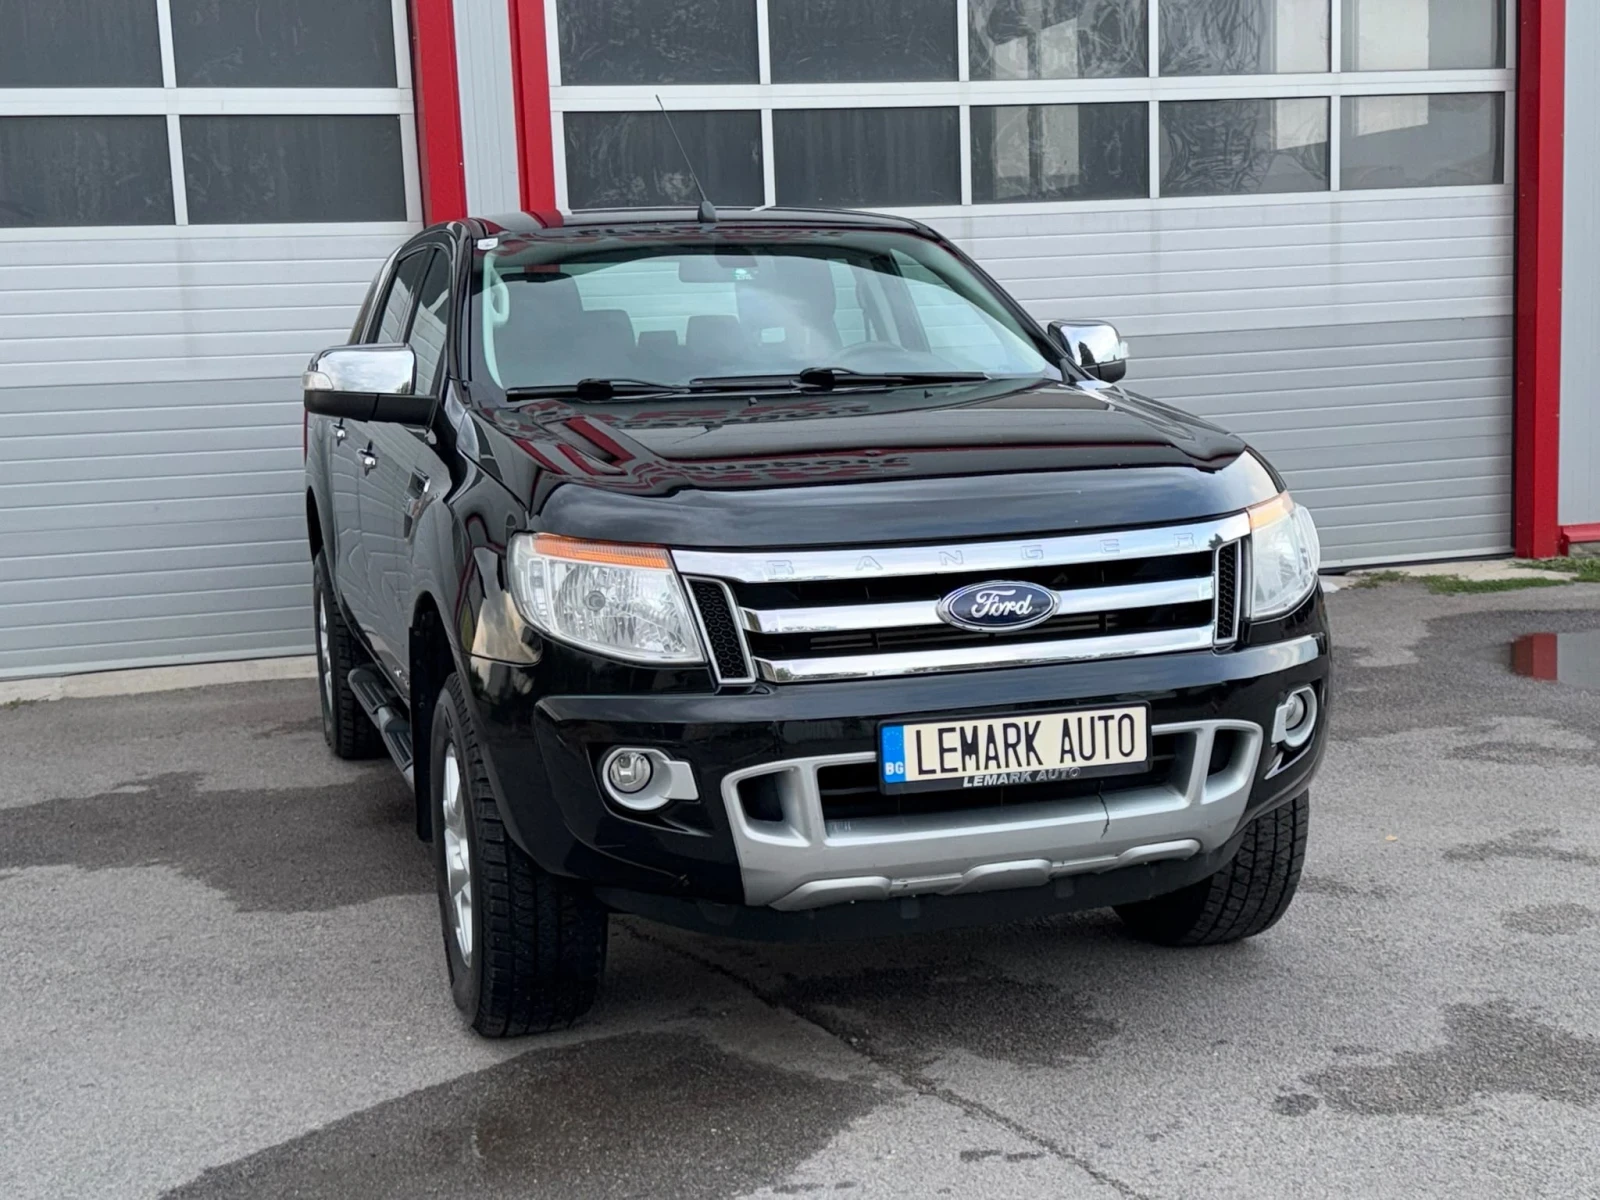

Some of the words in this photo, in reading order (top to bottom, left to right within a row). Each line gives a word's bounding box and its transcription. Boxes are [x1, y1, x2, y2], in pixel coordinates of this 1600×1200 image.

[970, 589, 1033, 619] Ford
[915, 720, 1044, 776] LEMARK
[1059, 713, 1136, 764] AUTO
[885, 761, 905, 776] BG
[963, 770, 1034, 788] LEMARK
[1036, 766, 1082, 782] AUTO
